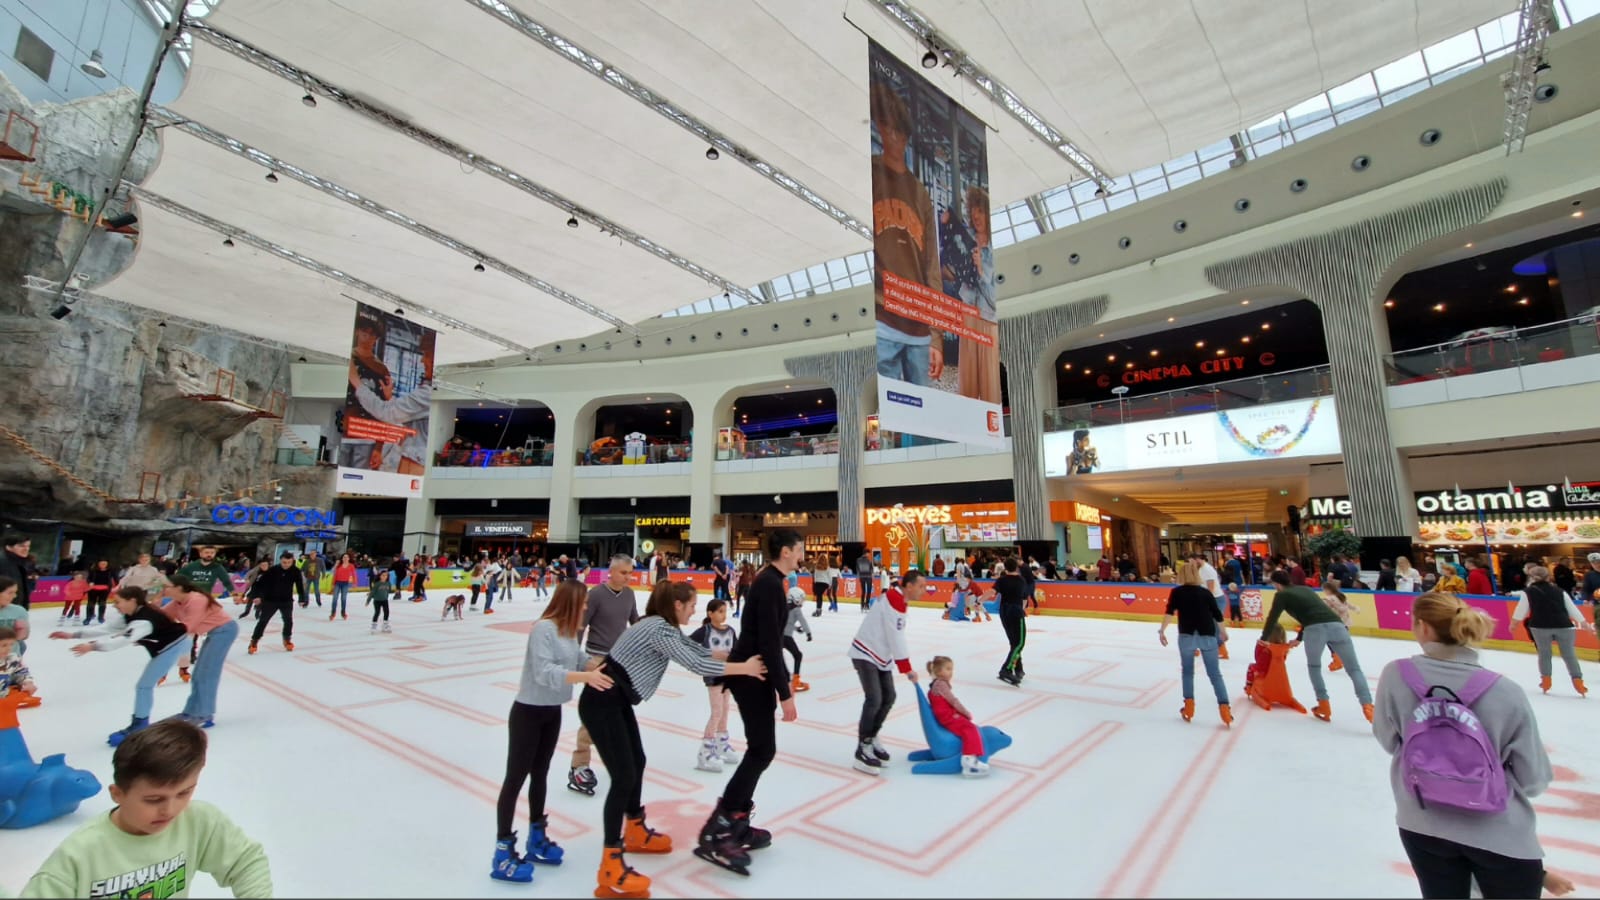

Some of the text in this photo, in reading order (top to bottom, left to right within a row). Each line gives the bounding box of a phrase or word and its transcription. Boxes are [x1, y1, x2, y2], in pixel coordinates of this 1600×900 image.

[875, 60, 892, 77] ING
[1122, 363, 1192, 385] CINEMA
[1200, 356, 1245, 374] CITY
[1146, 429, 1193, 449] STIL
[474, 525, 524, 533] IL VENETIANO
[90, 853, 185, 896] SURVIVAL
